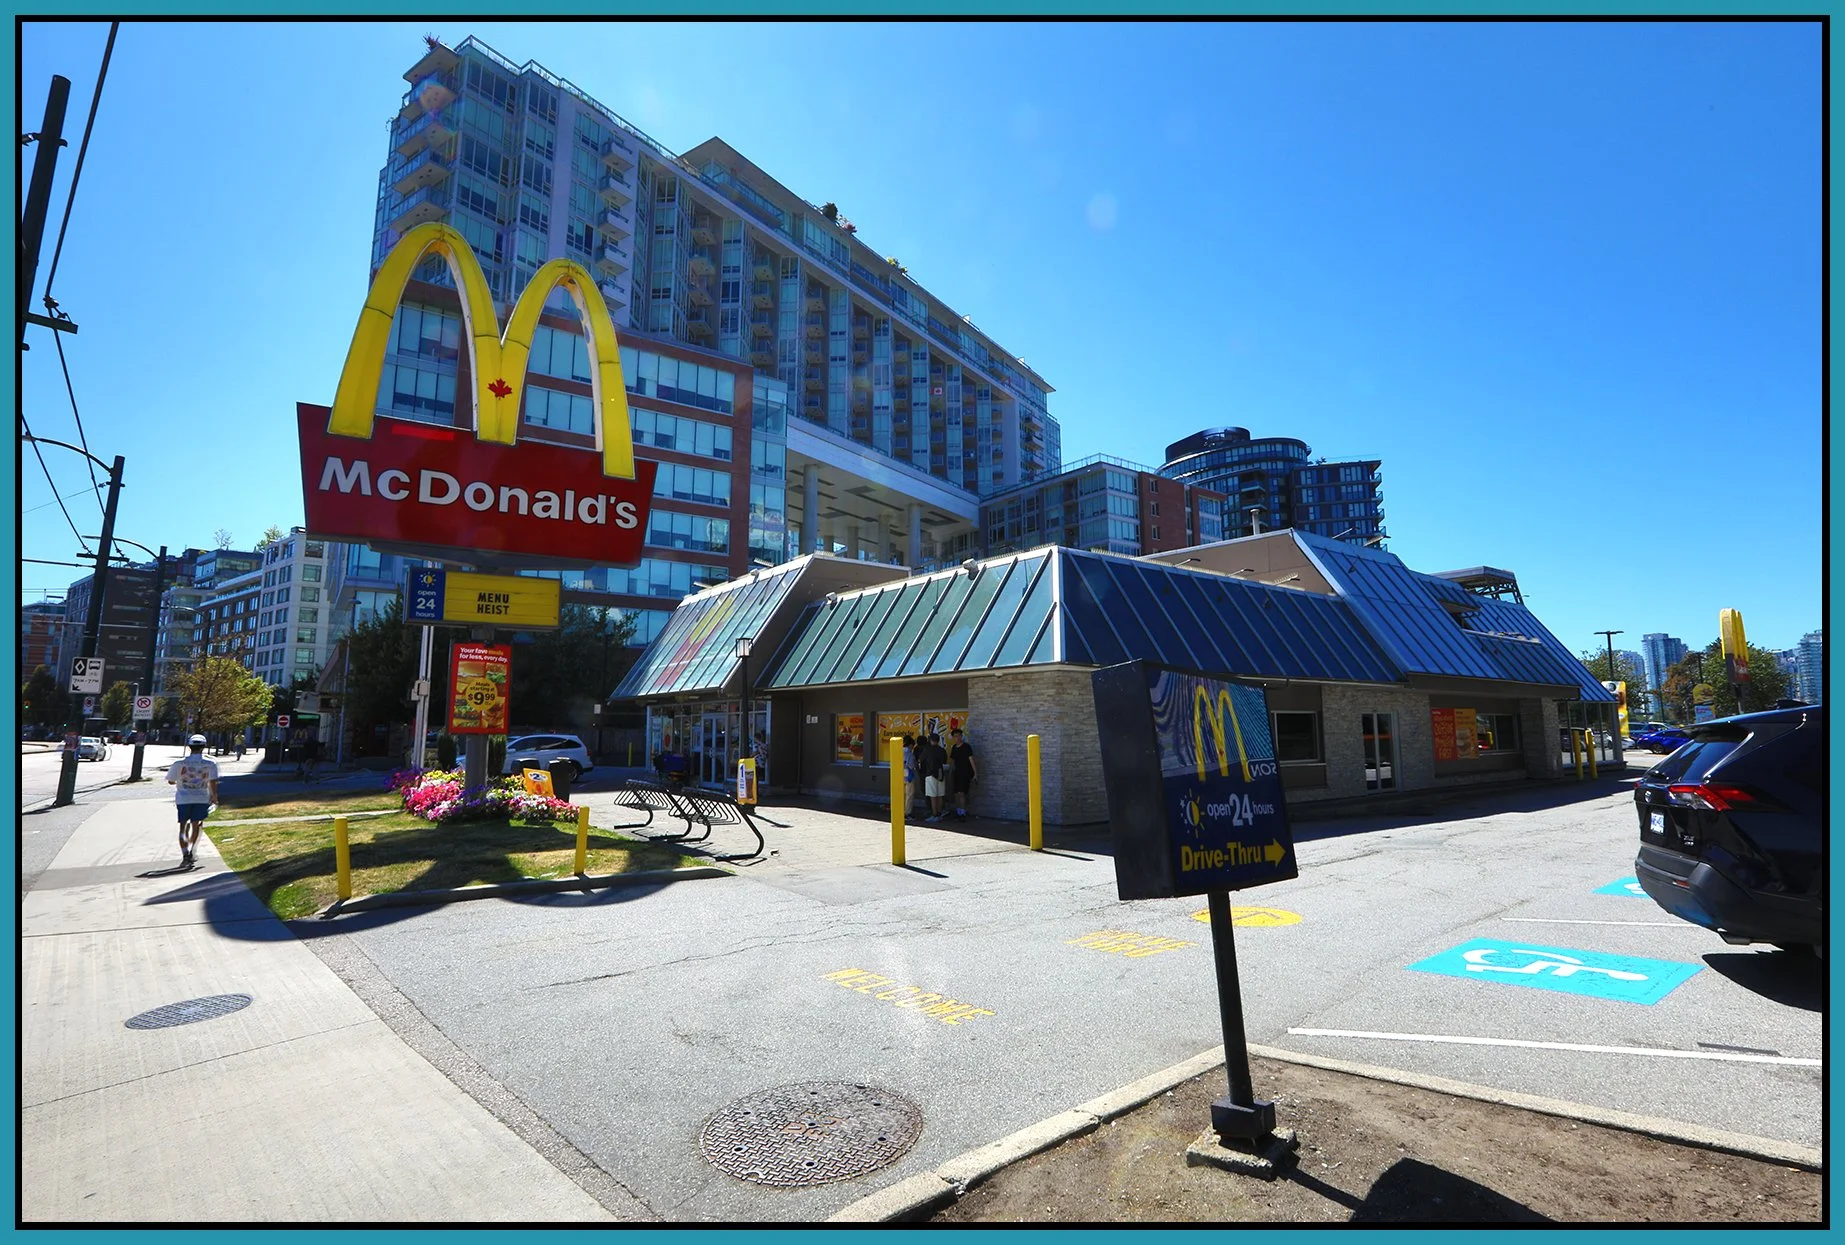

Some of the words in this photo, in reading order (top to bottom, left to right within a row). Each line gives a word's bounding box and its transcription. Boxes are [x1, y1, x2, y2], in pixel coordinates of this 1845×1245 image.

[318, 456, 639, 531] McDonald's
[416, 597, 436, 609] 24
[476, 603, 510, 615] HEIST
[477, 592, 510, 604] MENU
[1206, 803, 1231, 820] open
[1229, 793, 1254, 827] 24
[1252, 801, 1274, 815] hours
[1180, 841, 1262, 872] Drive-Thru
[818, 967, 996, 1026] WELCOME
